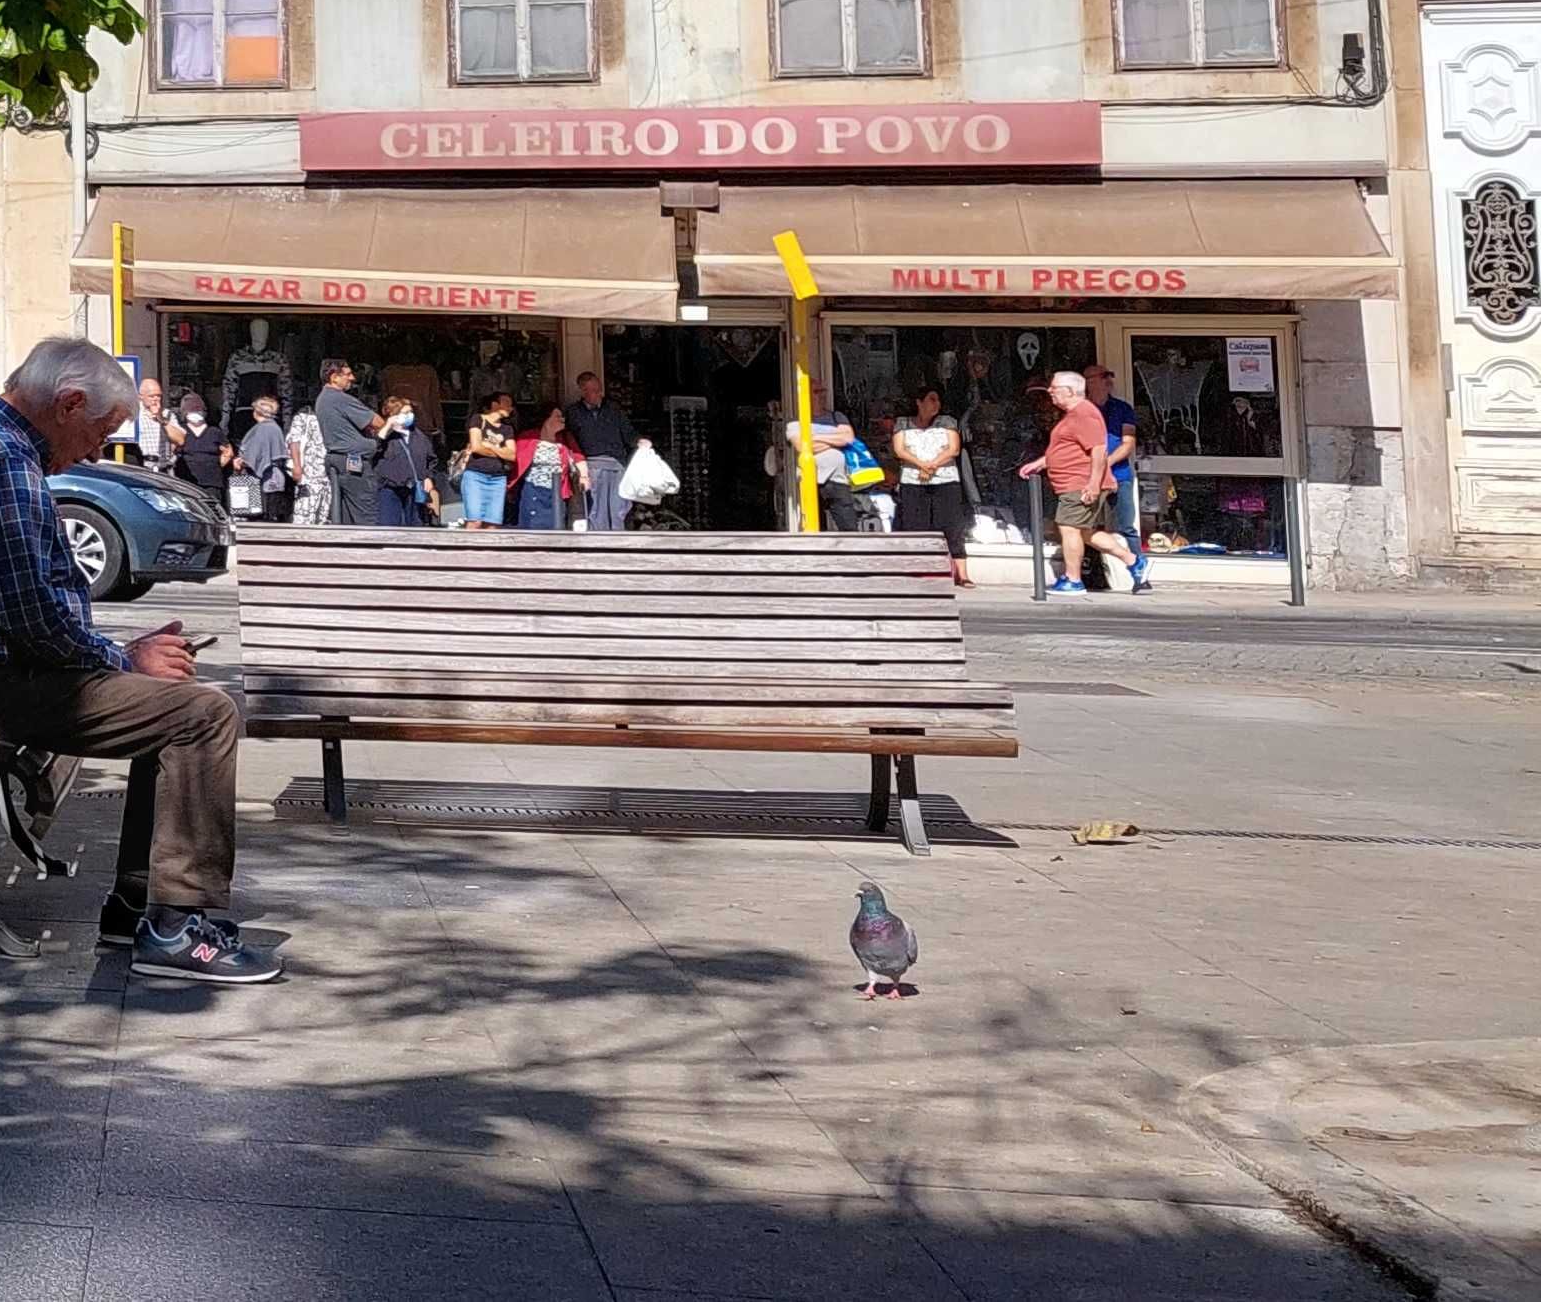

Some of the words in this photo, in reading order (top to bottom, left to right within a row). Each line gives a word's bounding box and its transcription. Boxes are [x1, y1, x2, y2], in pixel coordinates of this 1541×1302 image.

[380, 119, 679, 159] CELEIRO
[698, 118, 798, 156] DO
[816, 114, 1011, 155] POVO
[194, 276, 302, 300] BAZAR
[322, 281, 367, 303] DO
[387, 284, 537, 311] ORIENTE
[893, 268, 1006, 291] MULTI
[191, 942, 219, 963] N
